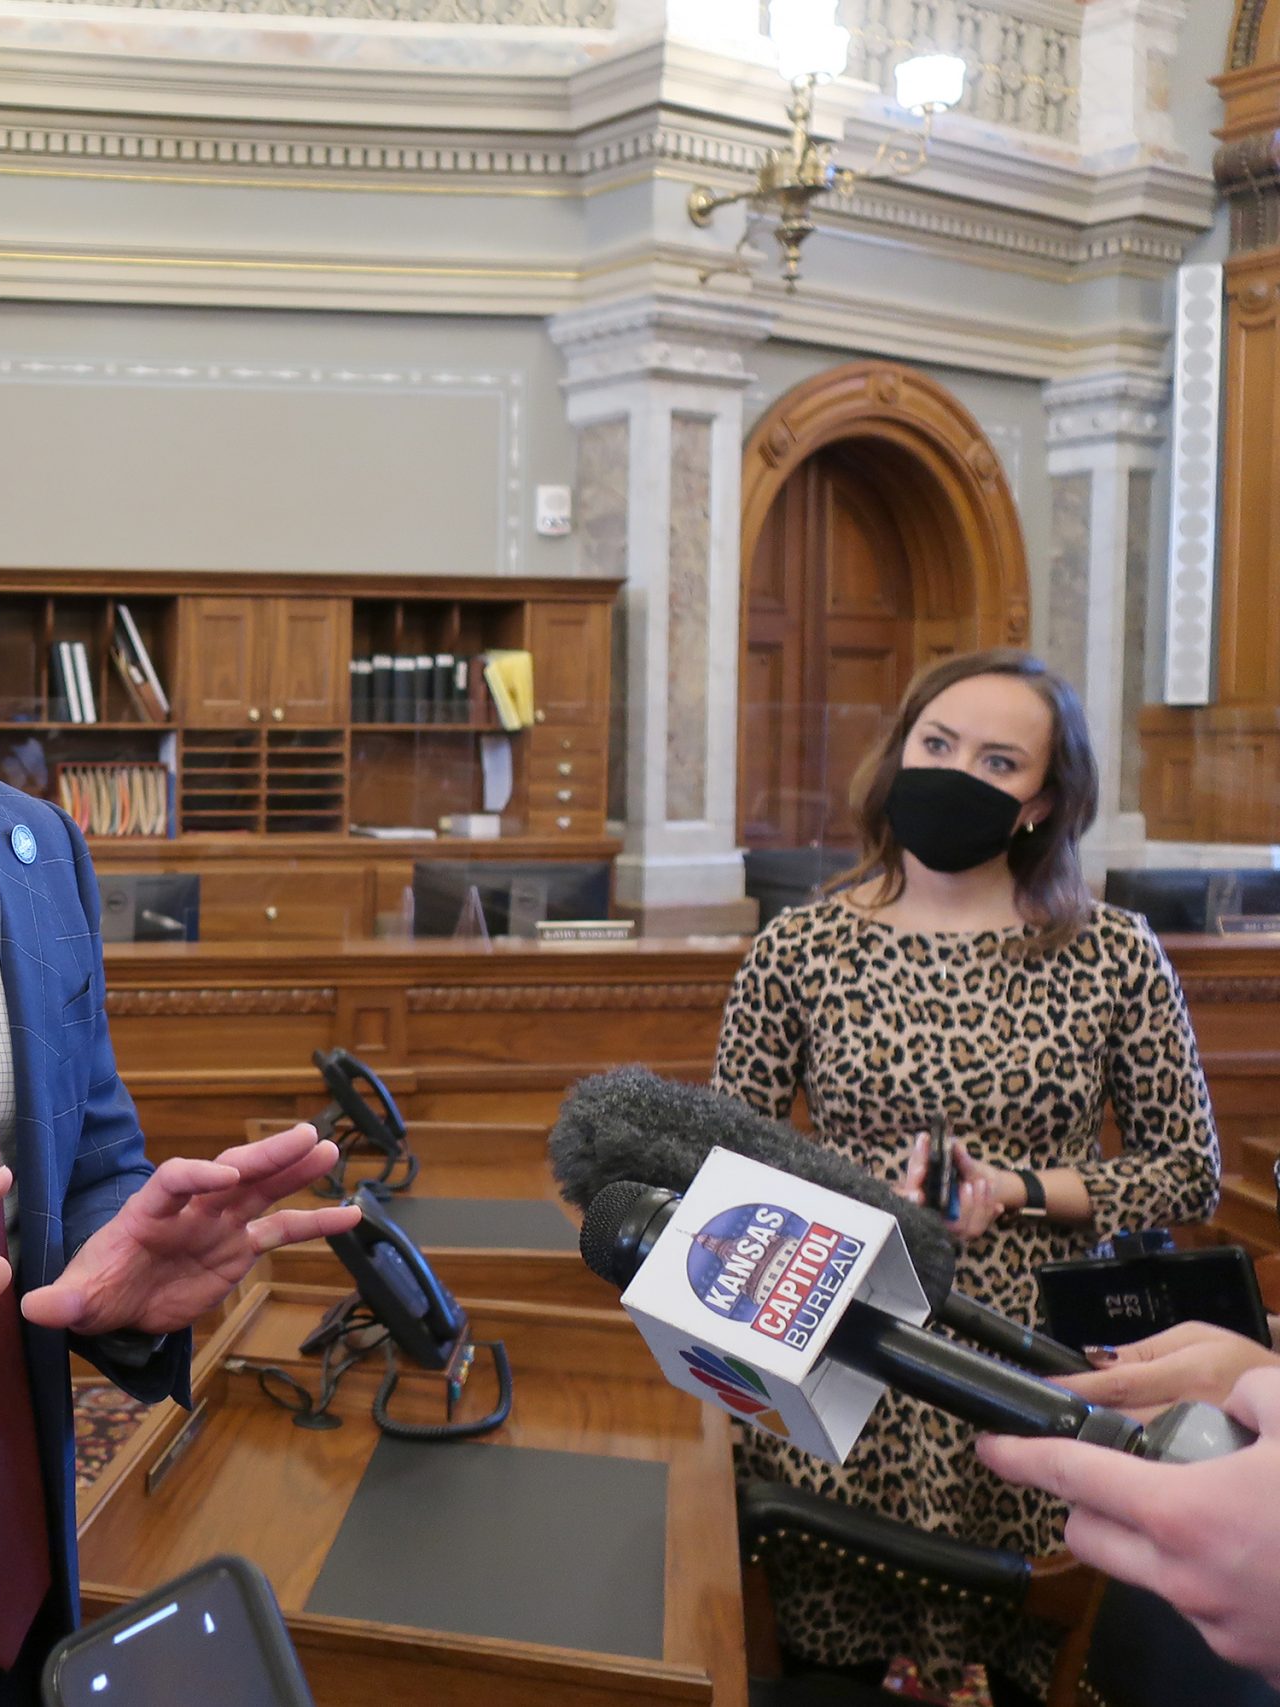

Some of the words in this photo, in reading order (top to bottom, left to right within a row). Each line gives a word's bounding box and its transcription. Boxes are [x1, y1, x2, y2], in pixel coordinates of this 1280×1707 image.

[705, 1207, 784, 1311] KANSAS
[758, 1232, 838, 1336] CAPITOL
[783, 1236, 862, 1349] BUREAU
